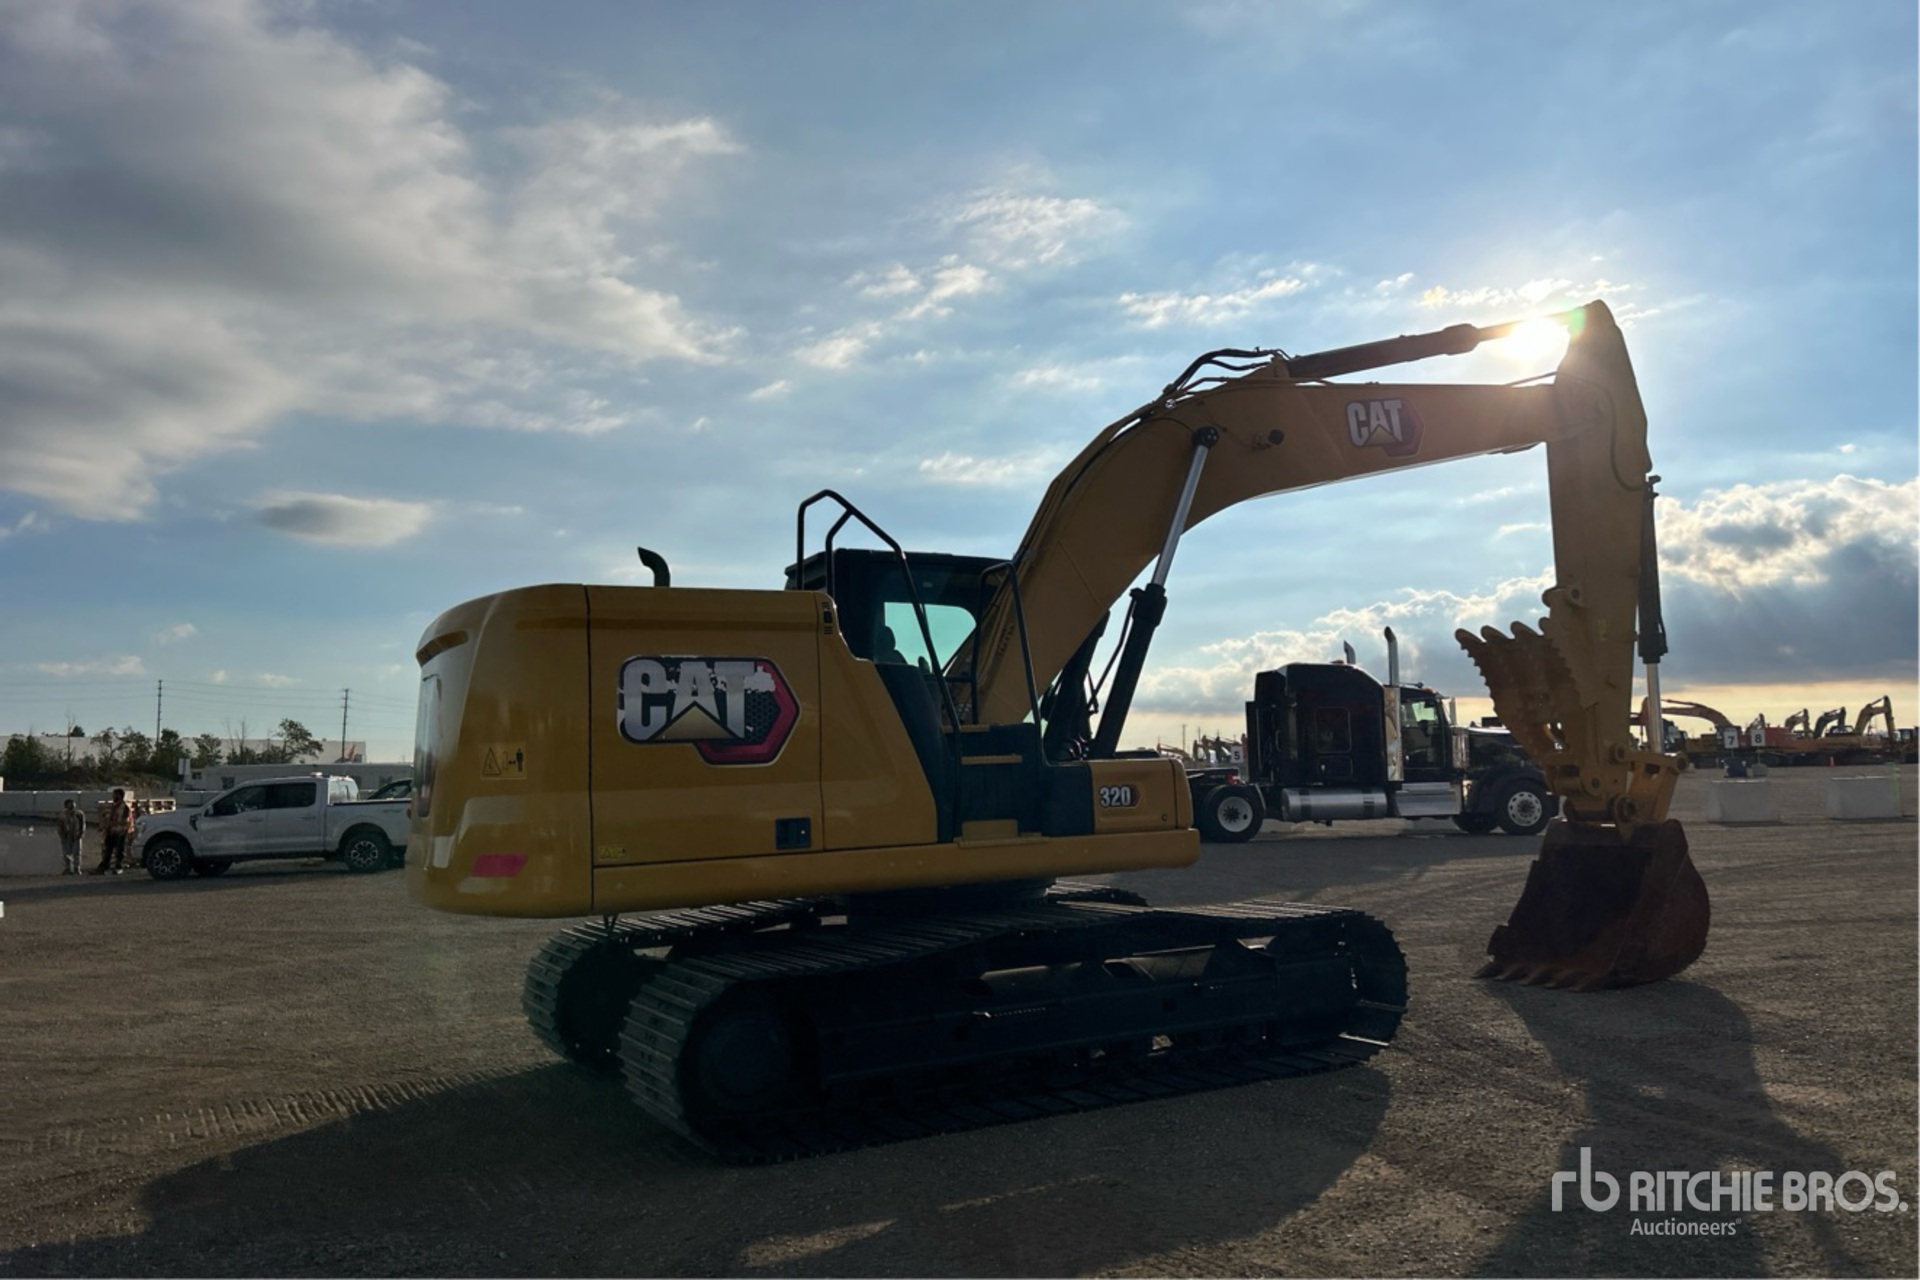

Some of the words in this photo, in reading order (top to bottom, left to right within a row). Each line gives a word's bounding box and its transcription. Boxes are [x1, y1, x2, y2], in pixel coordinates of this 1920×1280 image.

[1347, 401, 1403, 447] CAT
[623, 659, 756, 741] CAT
[1100, 786, 1131, 807] 320
